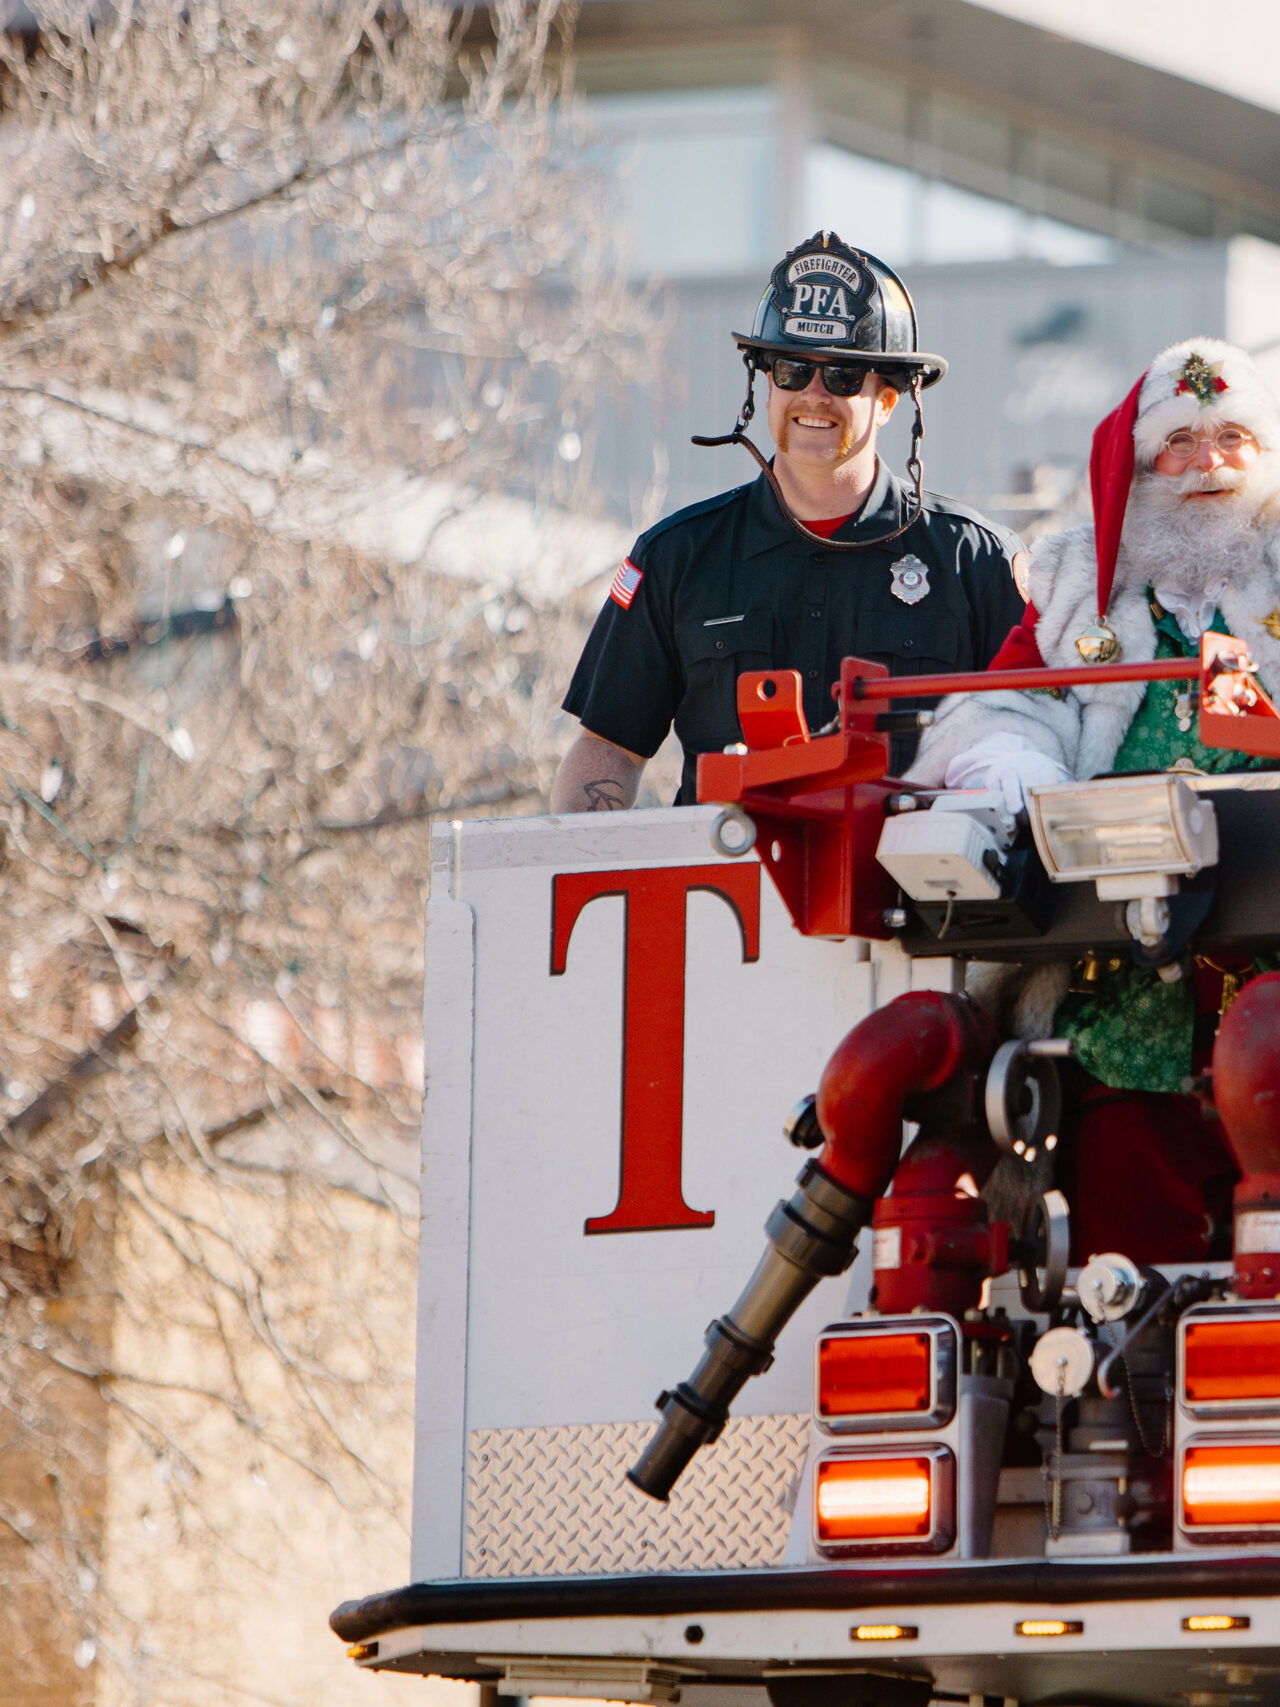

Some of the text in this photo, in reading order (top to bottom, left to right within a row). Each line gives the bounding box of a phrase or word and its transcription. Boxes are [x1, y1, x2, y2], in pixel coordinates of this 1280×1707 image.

[795, 258, 857, 283] FIREFIGHTER
[791, 284, 851, 318] PFA
[796, 321, 835, 335] MUTCH
[549, 861, 761, 1236] T
